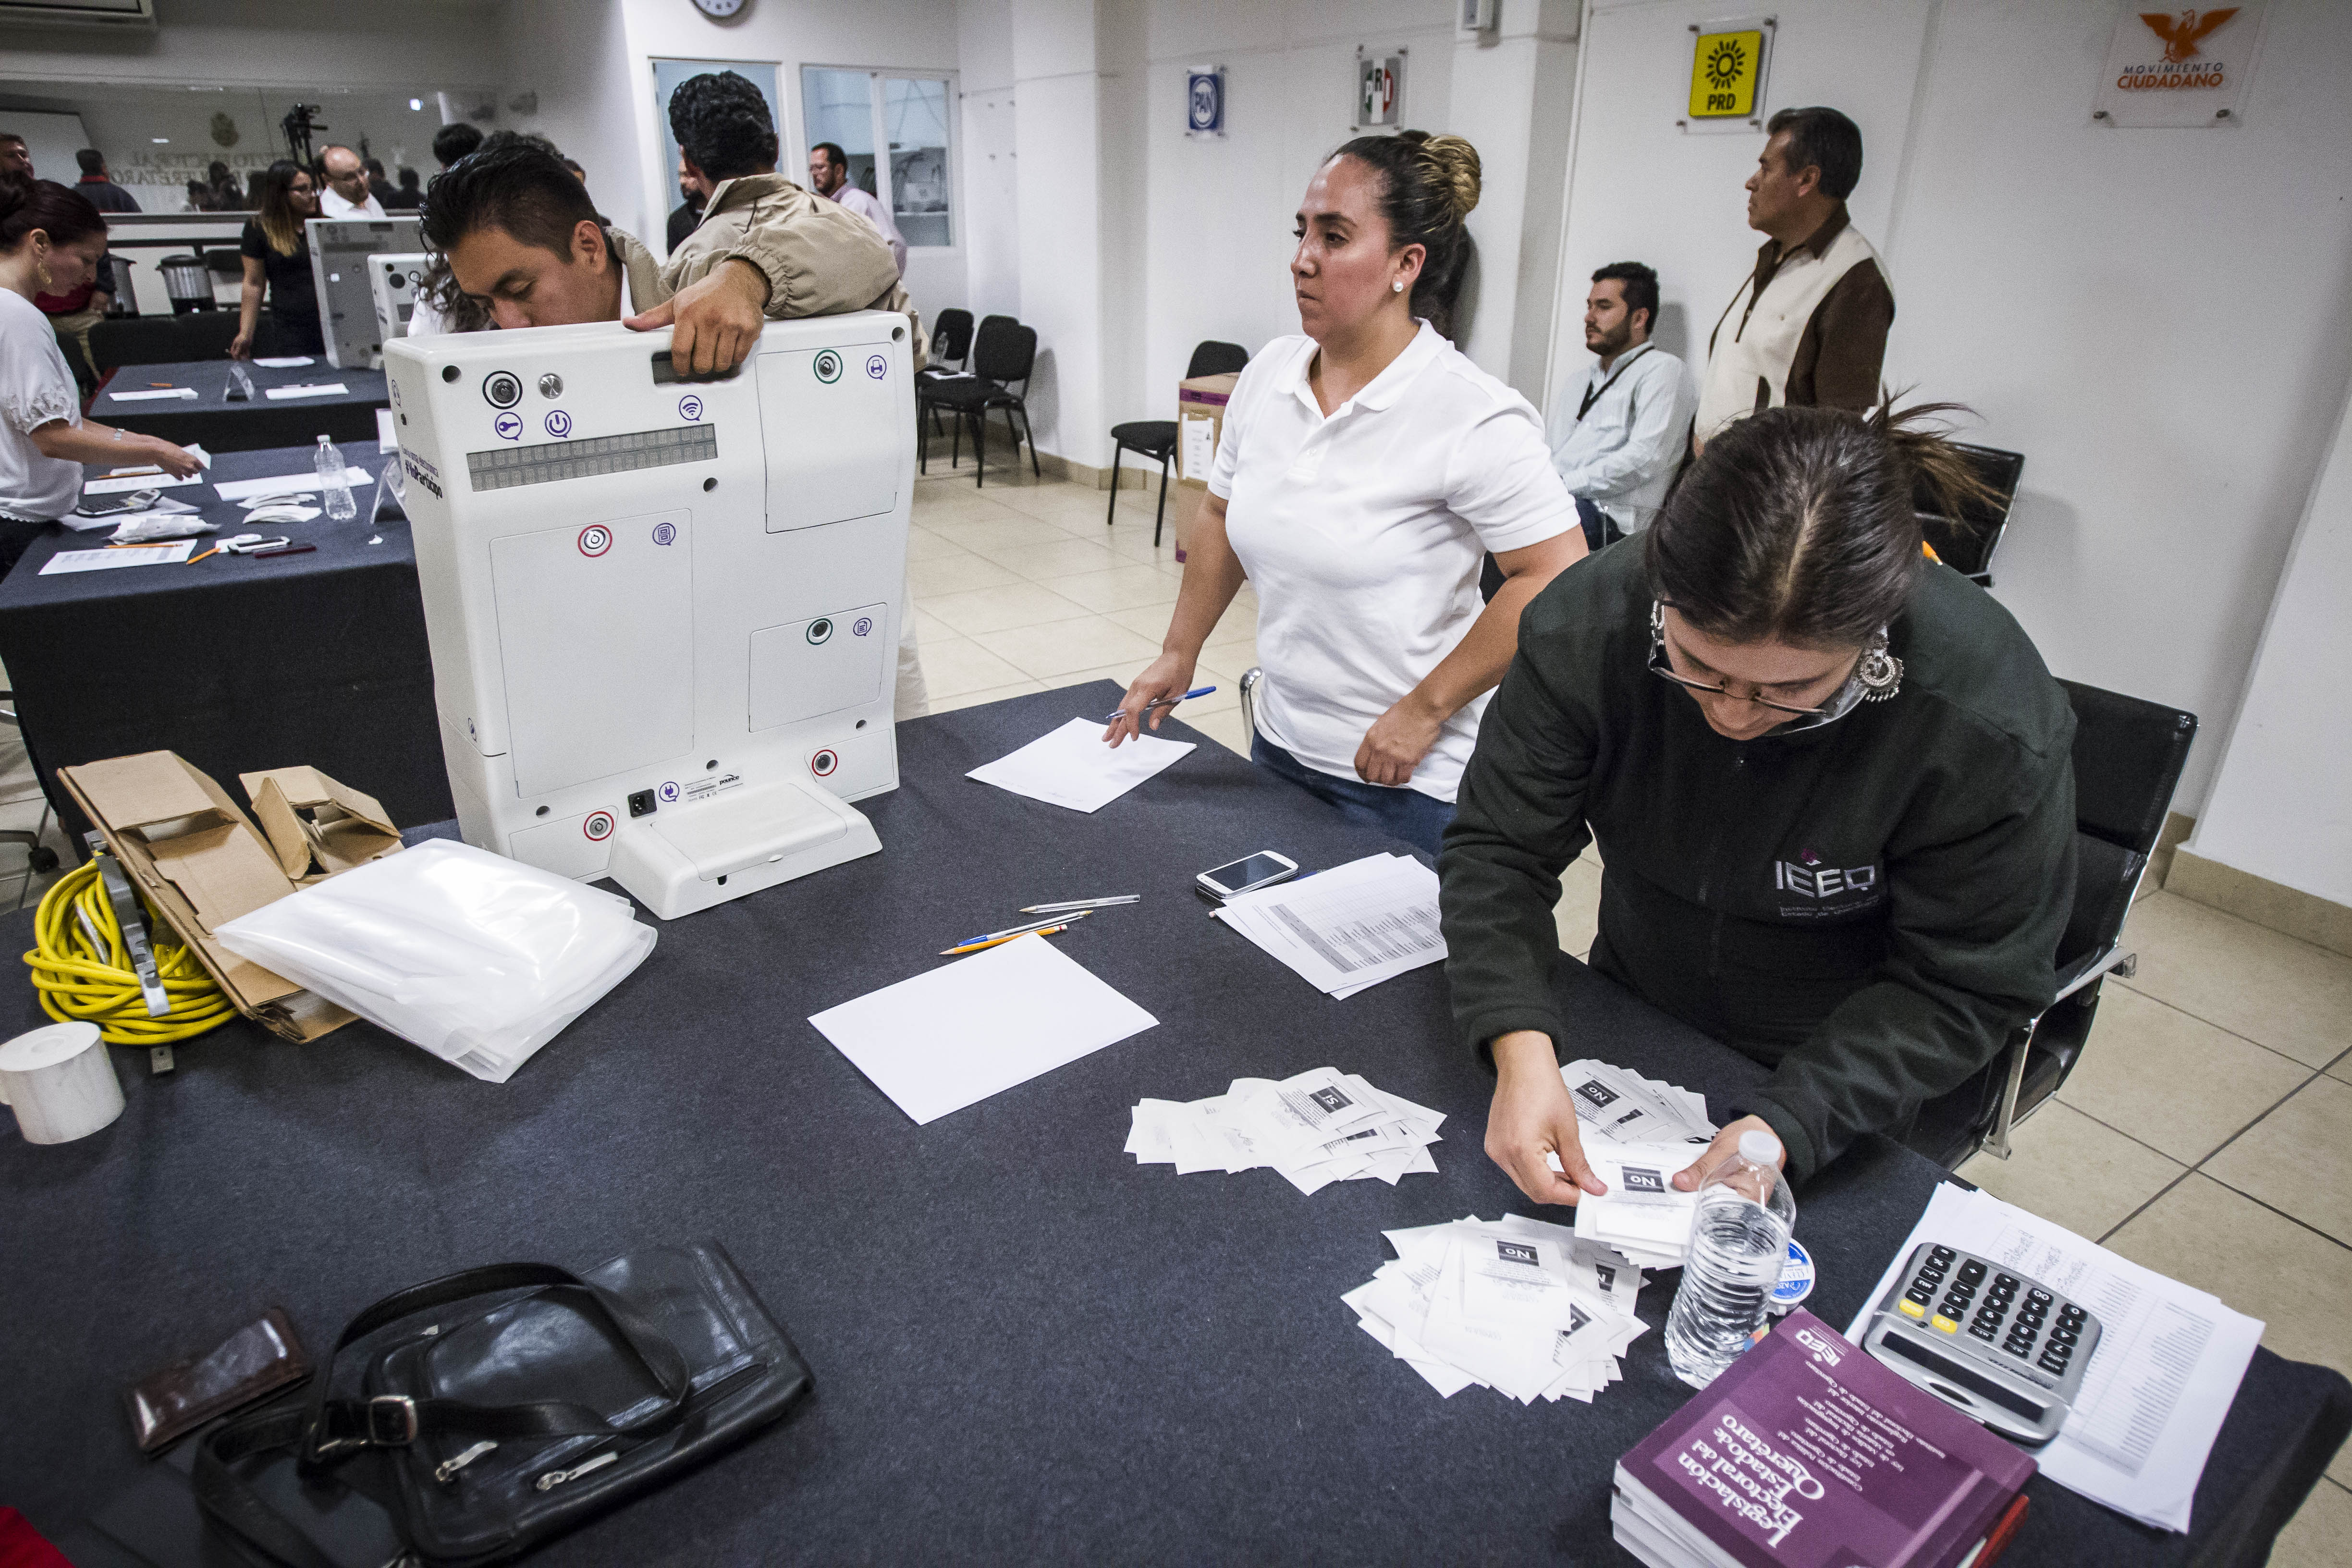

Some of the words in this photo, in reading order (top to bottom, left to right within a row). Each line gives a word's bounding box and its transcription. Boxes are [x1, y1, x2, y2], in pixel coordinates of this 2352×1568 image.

[2123, 62, 2223, 74] MOVIMIENTO
[2117, 73, 2223, 88] CIUDADANO
[1708, 93, 1736, 110] PRD
[719, 775, 740, 785] pounce
[1776, 860, 1875, 898] IEEQ
[1589, 1087, 1608, 1101] No
[1630, 1176, 1657, 1188] No
[1505, 1248, 1531, 1260] No
[2034, 1290, 2049, 1300] 00
[2032, 1302, 2040, 1311] 2
[1796, 1329, 1841, 1367] IEEQ
[1714, 1427, 1733, 1445] de
[1691, 1439, 1717, 1459] del
[1722, 1414, 1825, 1500] Querétaro
[1727, 1440, 1795, 1501] Estado
[1678, 1452, 1789, 1548] Legislación
[1711, 1457, 1803, 1533] Electoral
